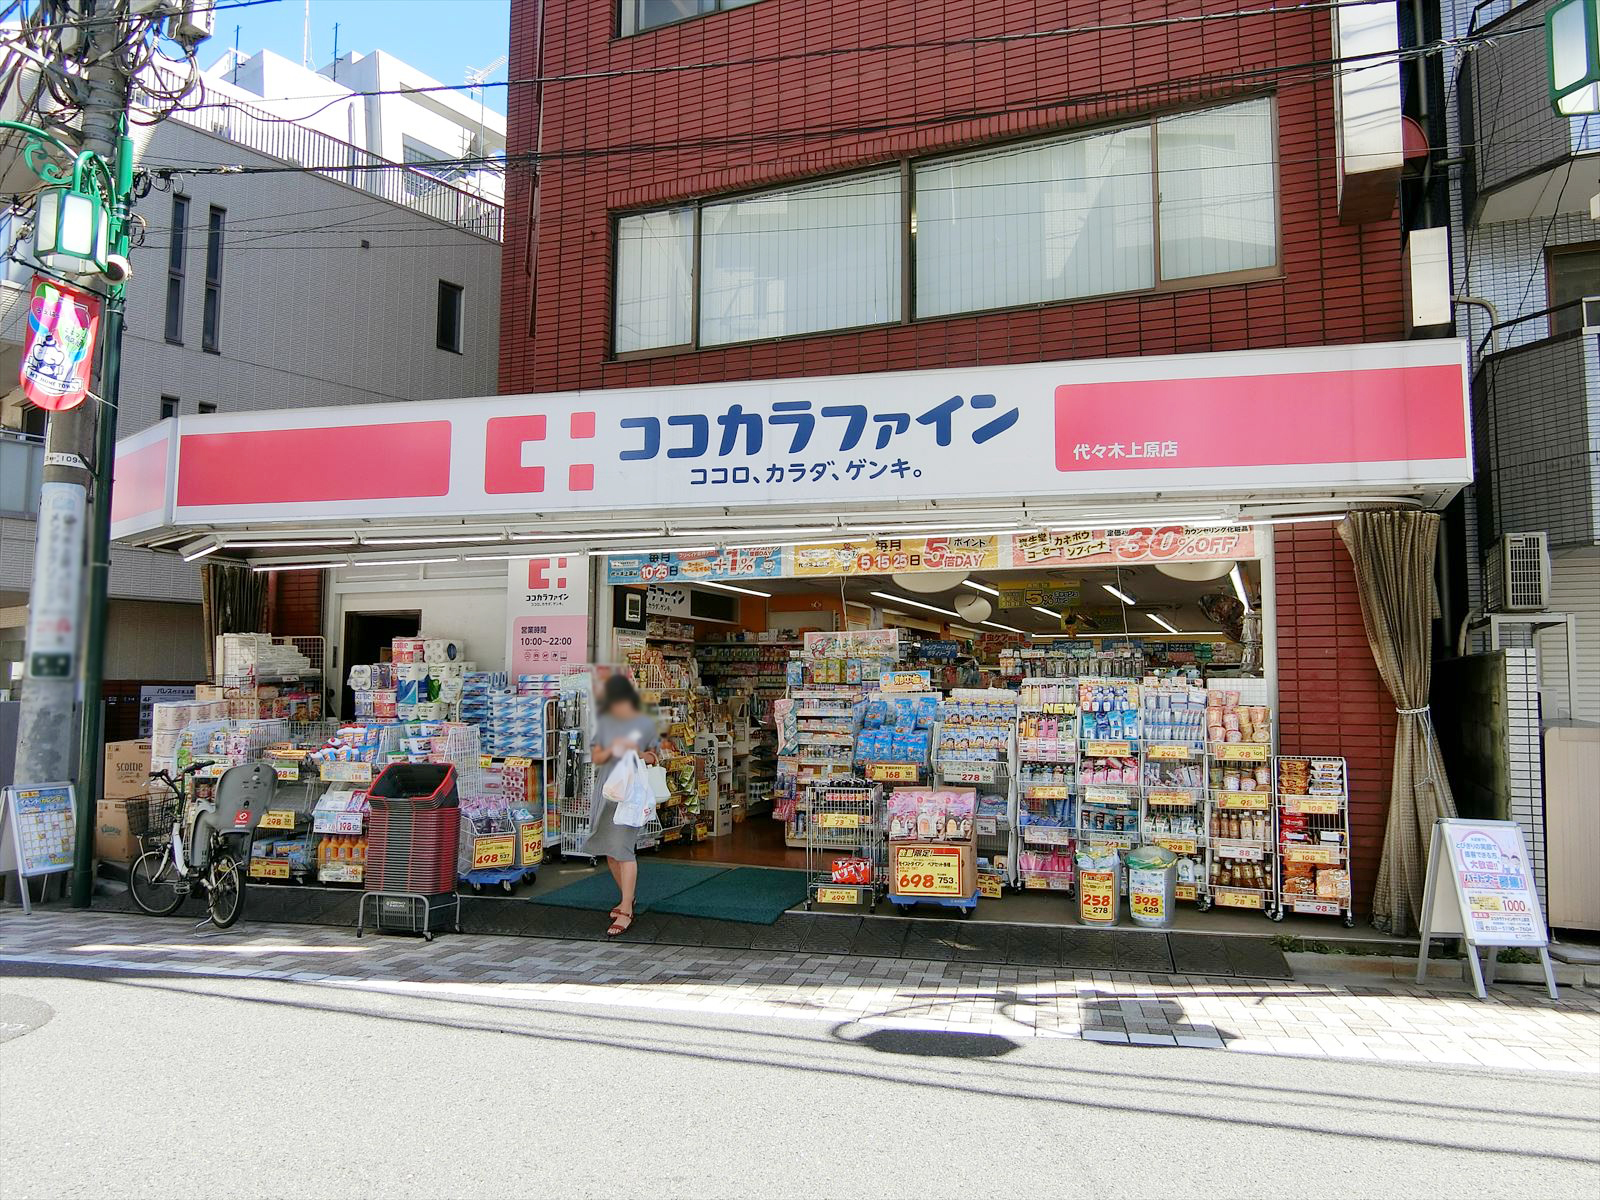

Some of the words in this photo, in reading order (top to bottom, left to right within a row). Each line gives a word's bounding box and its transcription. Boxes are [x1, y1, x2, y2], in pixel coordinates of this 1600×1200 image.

[619, 394, 1019, 461] ココカラファイン
[1073, 441, 1179, 460] 代々木上原店
[690, 459, 923, 486] ココロ、カラダ、ゲンキ。
[954, 538, 986, 547] ポイント
[1018, 532, 1048, 548] 資生堂
[1054, 531, 1090, 546] カネボウ
[875, 539, 902, 551] 毎月
[1067, 541, 1107, 557] ソフィーナ
[1027, 546, 1058, 559] コーセー
[860, 556, 871, 568] 5
[876, 556, 889, 568] 15
[893, 555, 908, 568] 25
[910, 555, 921, 565] 日
[641, 565, 654, 579] 10
[655, 564, 668, 578] 25
[670, 565, 678, 575] 日
[526, 593, 569, 601] ココカラファイン
[647, 584, 685, 604] ラファイン
[521, 626, 547, 634] 営業時間
[1043, 703, 1077, 715] NEW
[116, 762, 144, 772] scottie
[885, 771, 900, 779] 168
[267, 817, 282, 826] 298
[338, 821, 352, 831] 198
[524, 839, 542, 853] 198
[475, 853, 499, 864] 498
[263, 868, 277, 876] 148
[899, 873, 935, 889] 698
[938, 876, 955, 885] 753
[1083, 894, 1111, 906] 258
[1134, 895, 1159, 907] 398
[1502, 899, 1526, 912] 1000
[1143, 906, 1159, 914] 429
